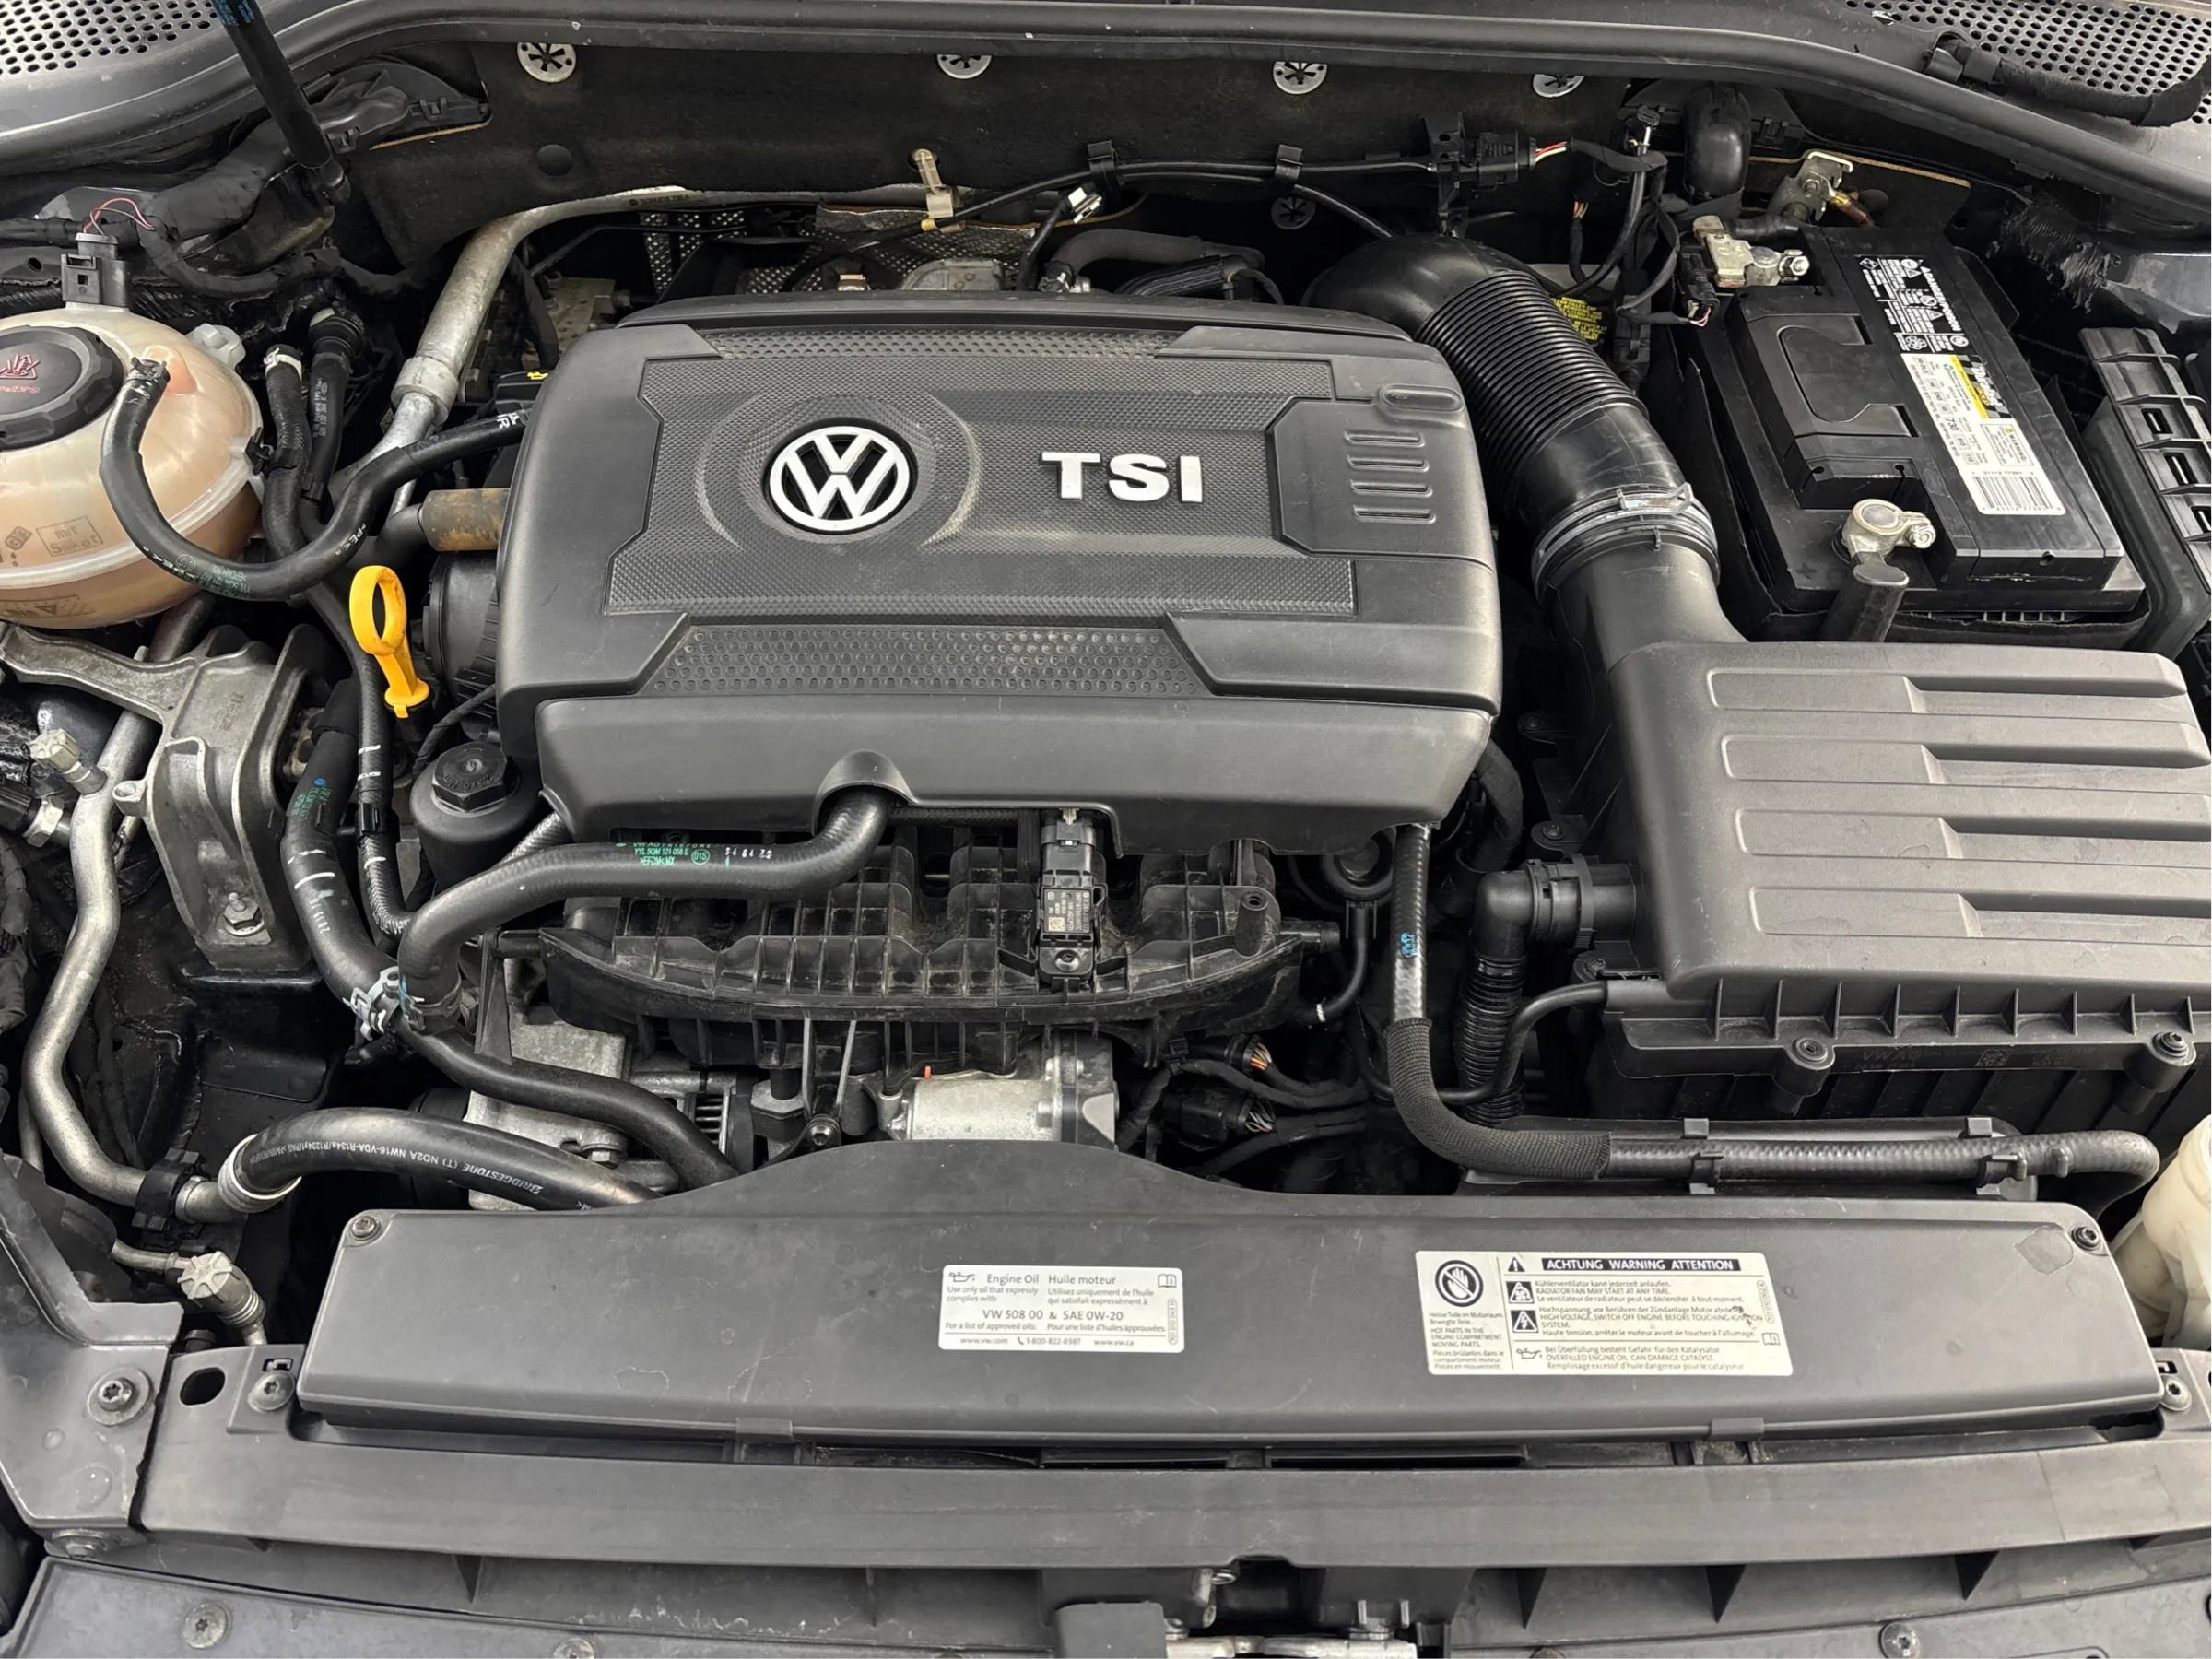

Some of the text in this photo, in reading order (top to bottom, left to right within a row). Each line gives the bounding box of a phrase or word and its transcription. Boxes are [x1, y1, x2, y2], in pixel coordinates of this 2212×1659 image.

[769, 425, 910, 532] VW
[1041, 452, 1203, 503] TSI
[409, 1150, 440, 1165] ND2A
[462, 1163, 544, 1195] BRIDGESTONE
[1547, 1259, 1734, 1270] ACHTUNG WARNING ATTENTION
[987, 1274, 1039, 1286] Engine Oil
[1048, 1275, 1116, 1285] Huile moteur
[1608, 1280, 1638, 1288] jederzeit
[962, 1287, 977, 1295] only
[1006, 1287, 1039, 1296] expressly
[1047, 1288, 1075, 1296] Utilisez
[1076, 1288, 1120, 1298] uniquement
[947, 1295, 978, 1303] complies
[1047, 1297, 1060, 1306] qui
[982, 1310, 1003, 1319] VW
[1005, 1310, 1026, 1320] 508
[1028, 1310, 1043, 1320] 00
[1049, 1312, 1057, 1320] &
[1063, 1311, 1084, 1320] SAE
[964, 1322, 976, 1330] list
[977, 1322, 985, 1330] of
[986, 1323, 1021, 1331] approved
[1080, 1324, 1095, 1332] liste
[1547, 1362, 1590, 1371] Remplissage
